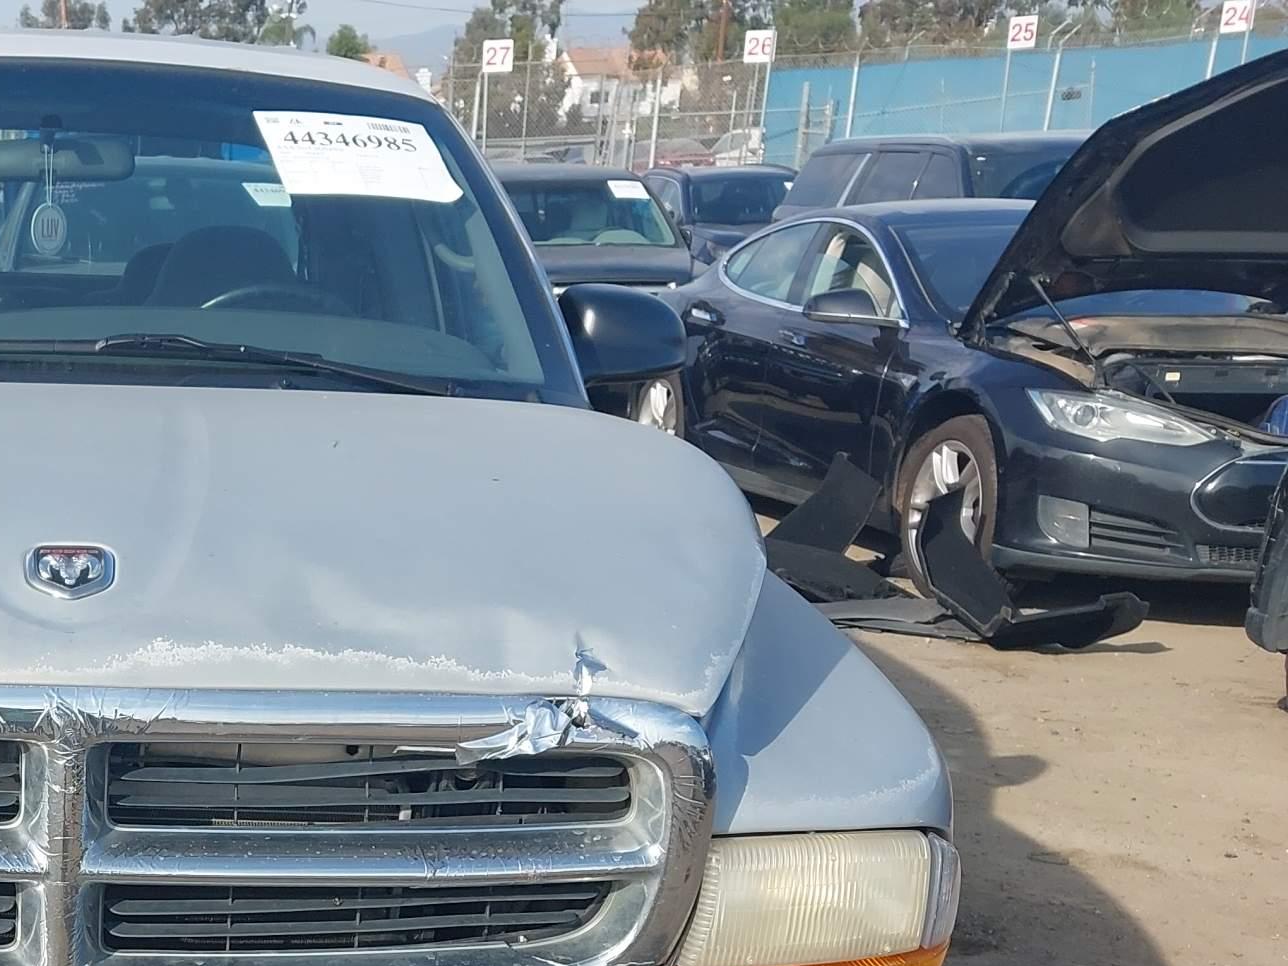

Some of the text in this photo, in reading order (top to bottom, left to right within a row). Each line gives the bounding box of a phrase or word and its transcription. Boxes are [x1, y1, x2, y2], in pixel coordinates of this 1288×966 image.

[1223, 5, 1250, 26] 24
[1011, 22, 1035, 42] 25
[486, 46, 510, 65] 27
[747, 36, 773, 56] 26
[283, 130, 417, 153] 44346985
